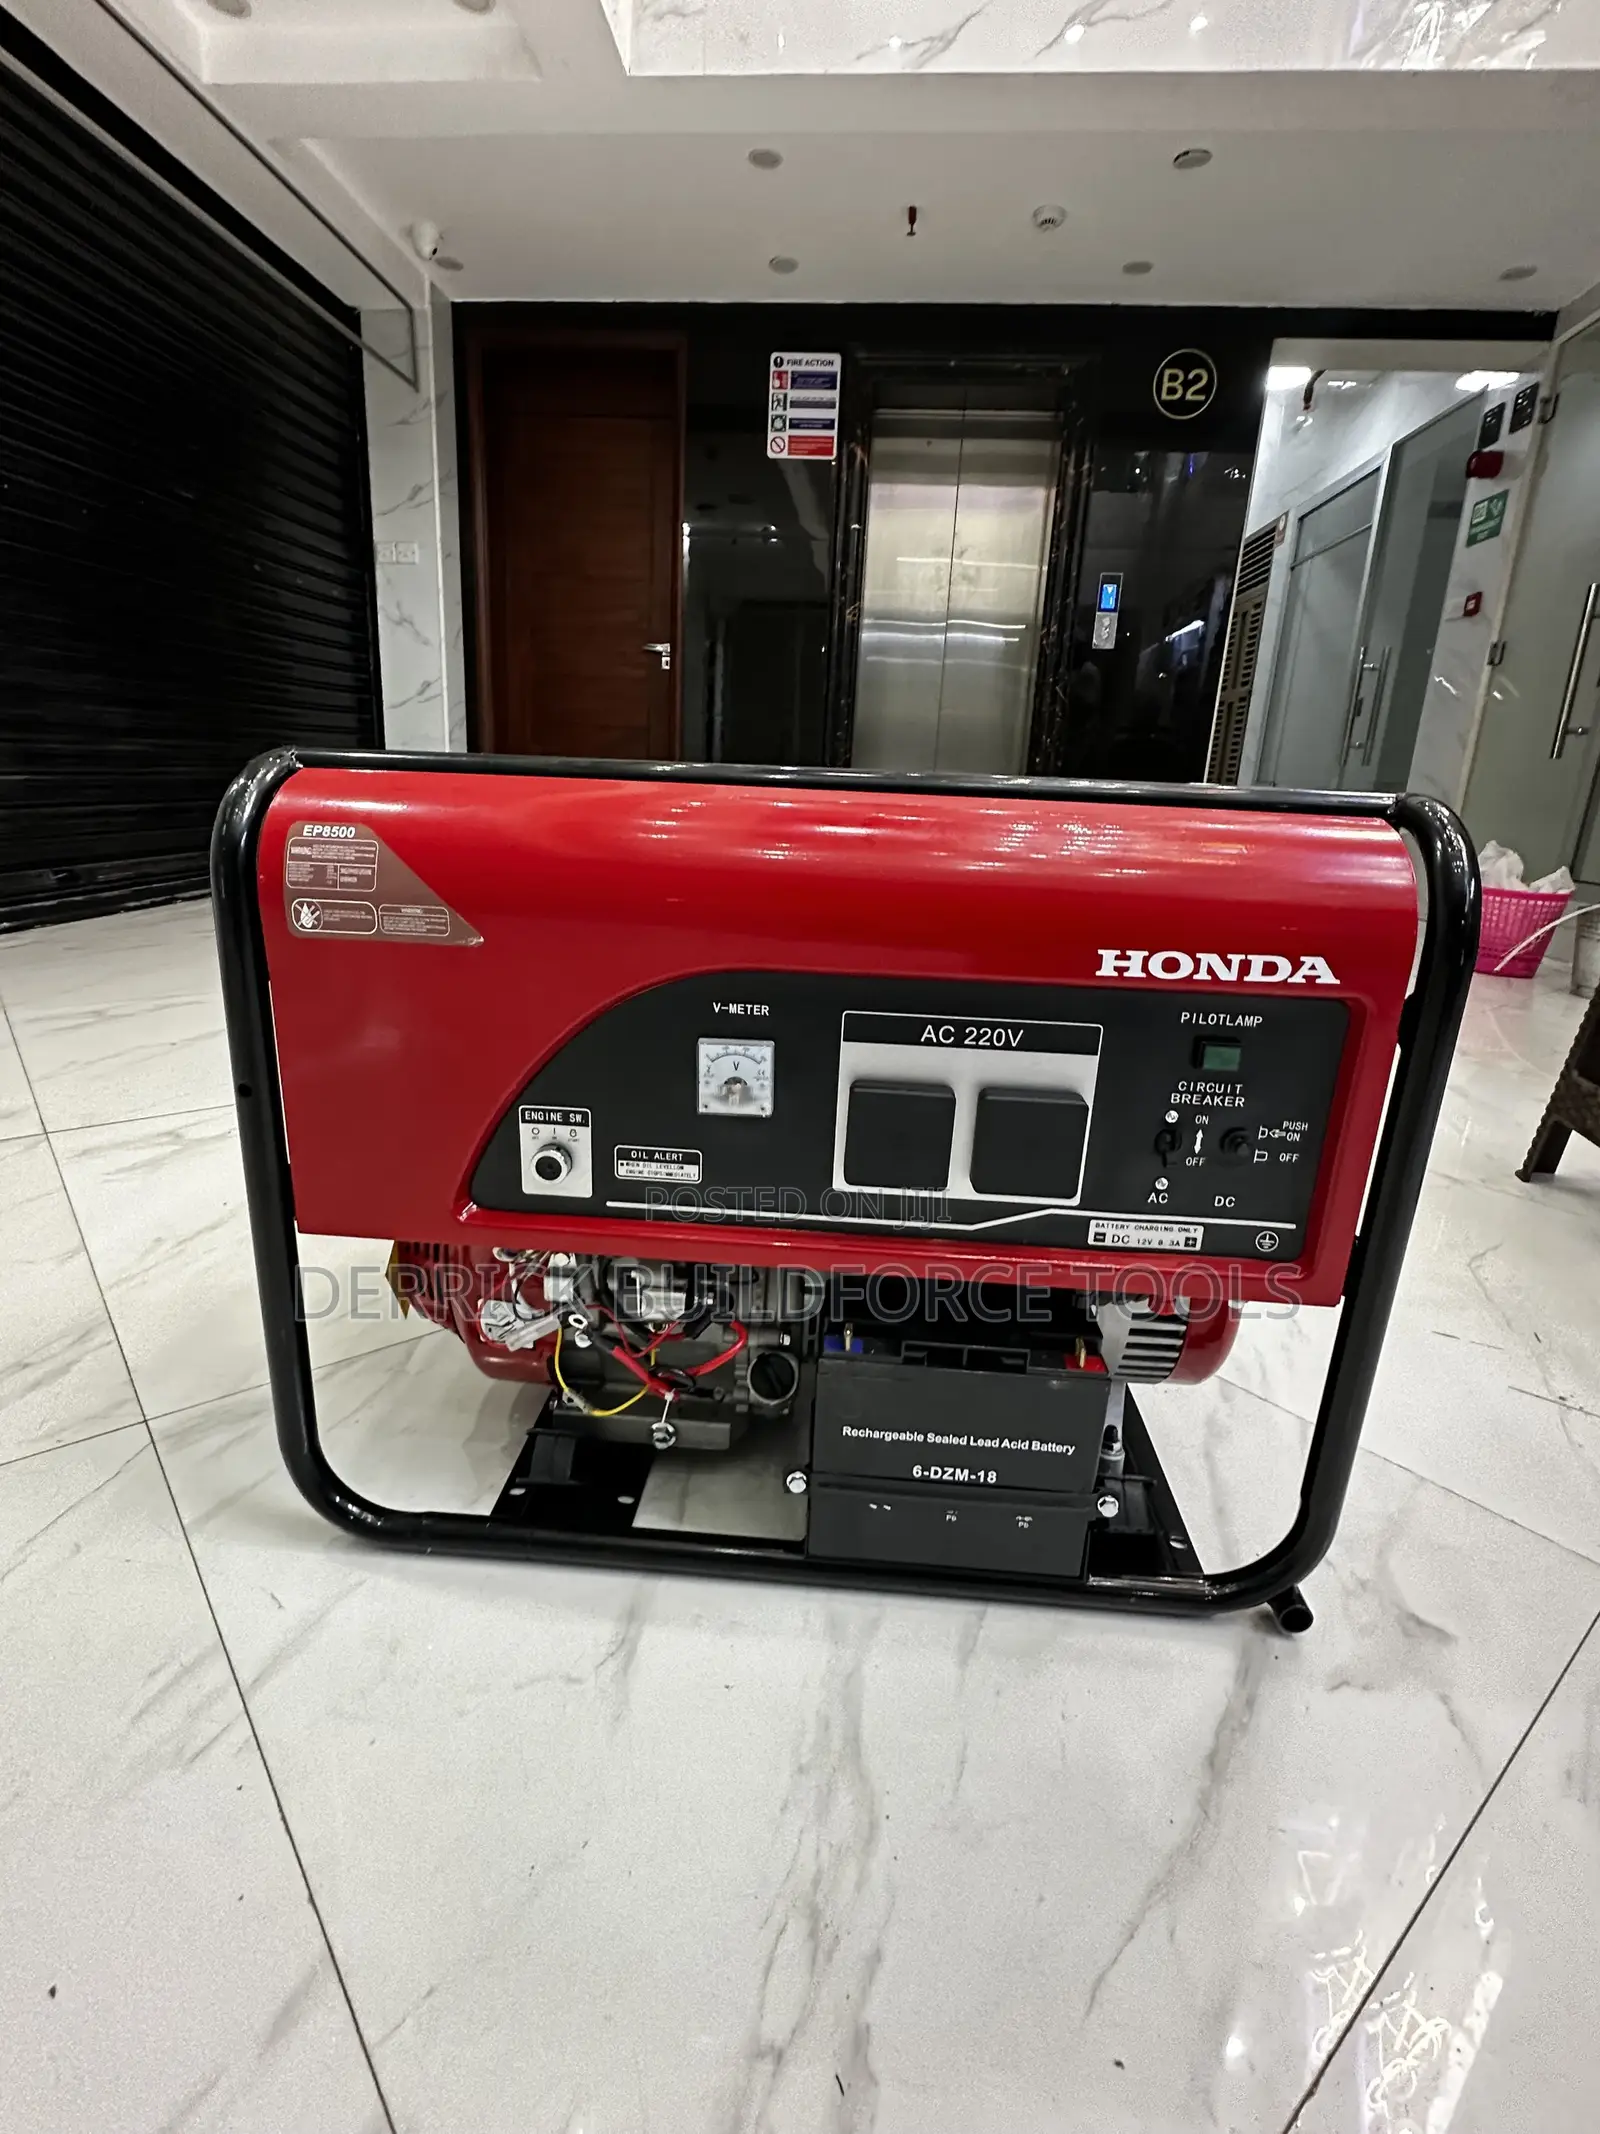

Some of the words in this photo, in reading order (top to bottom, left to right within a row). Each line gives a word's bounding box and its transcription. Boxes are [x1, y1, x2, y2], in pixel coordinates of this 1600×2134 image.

[804, 359, 834, 367] ACTION
[1161, 368, 1209, 401] B2
[302, 825, 356, 839] EP8500
[1095, 949, 1341, 985] HONDA
[712, 1002, 770, 1016] V-METER
[1180, 1011, 1263, 1028] PILOTLAMP
[920, 1024, 955, 1044] AC
[963, 1026, 1024, 1047] 220V
[733, 1061, 740, 1071] V
[1178, 1080, 1244, 1094] CIRCUIT
[1170, 1093, 1245, 1108] BREAKER
[525, 1110, 563, 1122] ENGINE
[1195, 1114, 1209, 1125] ON
[1282, 1120, 1309, 1131] PUSH
[1286, 1131, 1301, 1142] ON
[631, 1150, 649, 1159] OIL
[654, 1152, 683, 1161] ALERT
[1185, 1156, 1206, 1167] OFF
[1279, 1152, 1300, 1163] OFF
[1147, 1192, 1169, 1204] AC
[1214, 1195, 1236, 1208] DC
[1095, 1222, 1130, 1230] BATTERY
[1111, 1234, 1131, 1245] DC
[1137, 1238, 1153, 1246] 12V
[842, 1426, 924, 1442] Rechargeable
[926, 1432, 967, 1446] Sealed
[969, 1436, 999, 1448] Lead
[1000, 1438, 1029, 1450] Acid
[1031, 1441, 1076, 1456] Battery
[912, 1464, 998, 1484] 6-DZM-18
